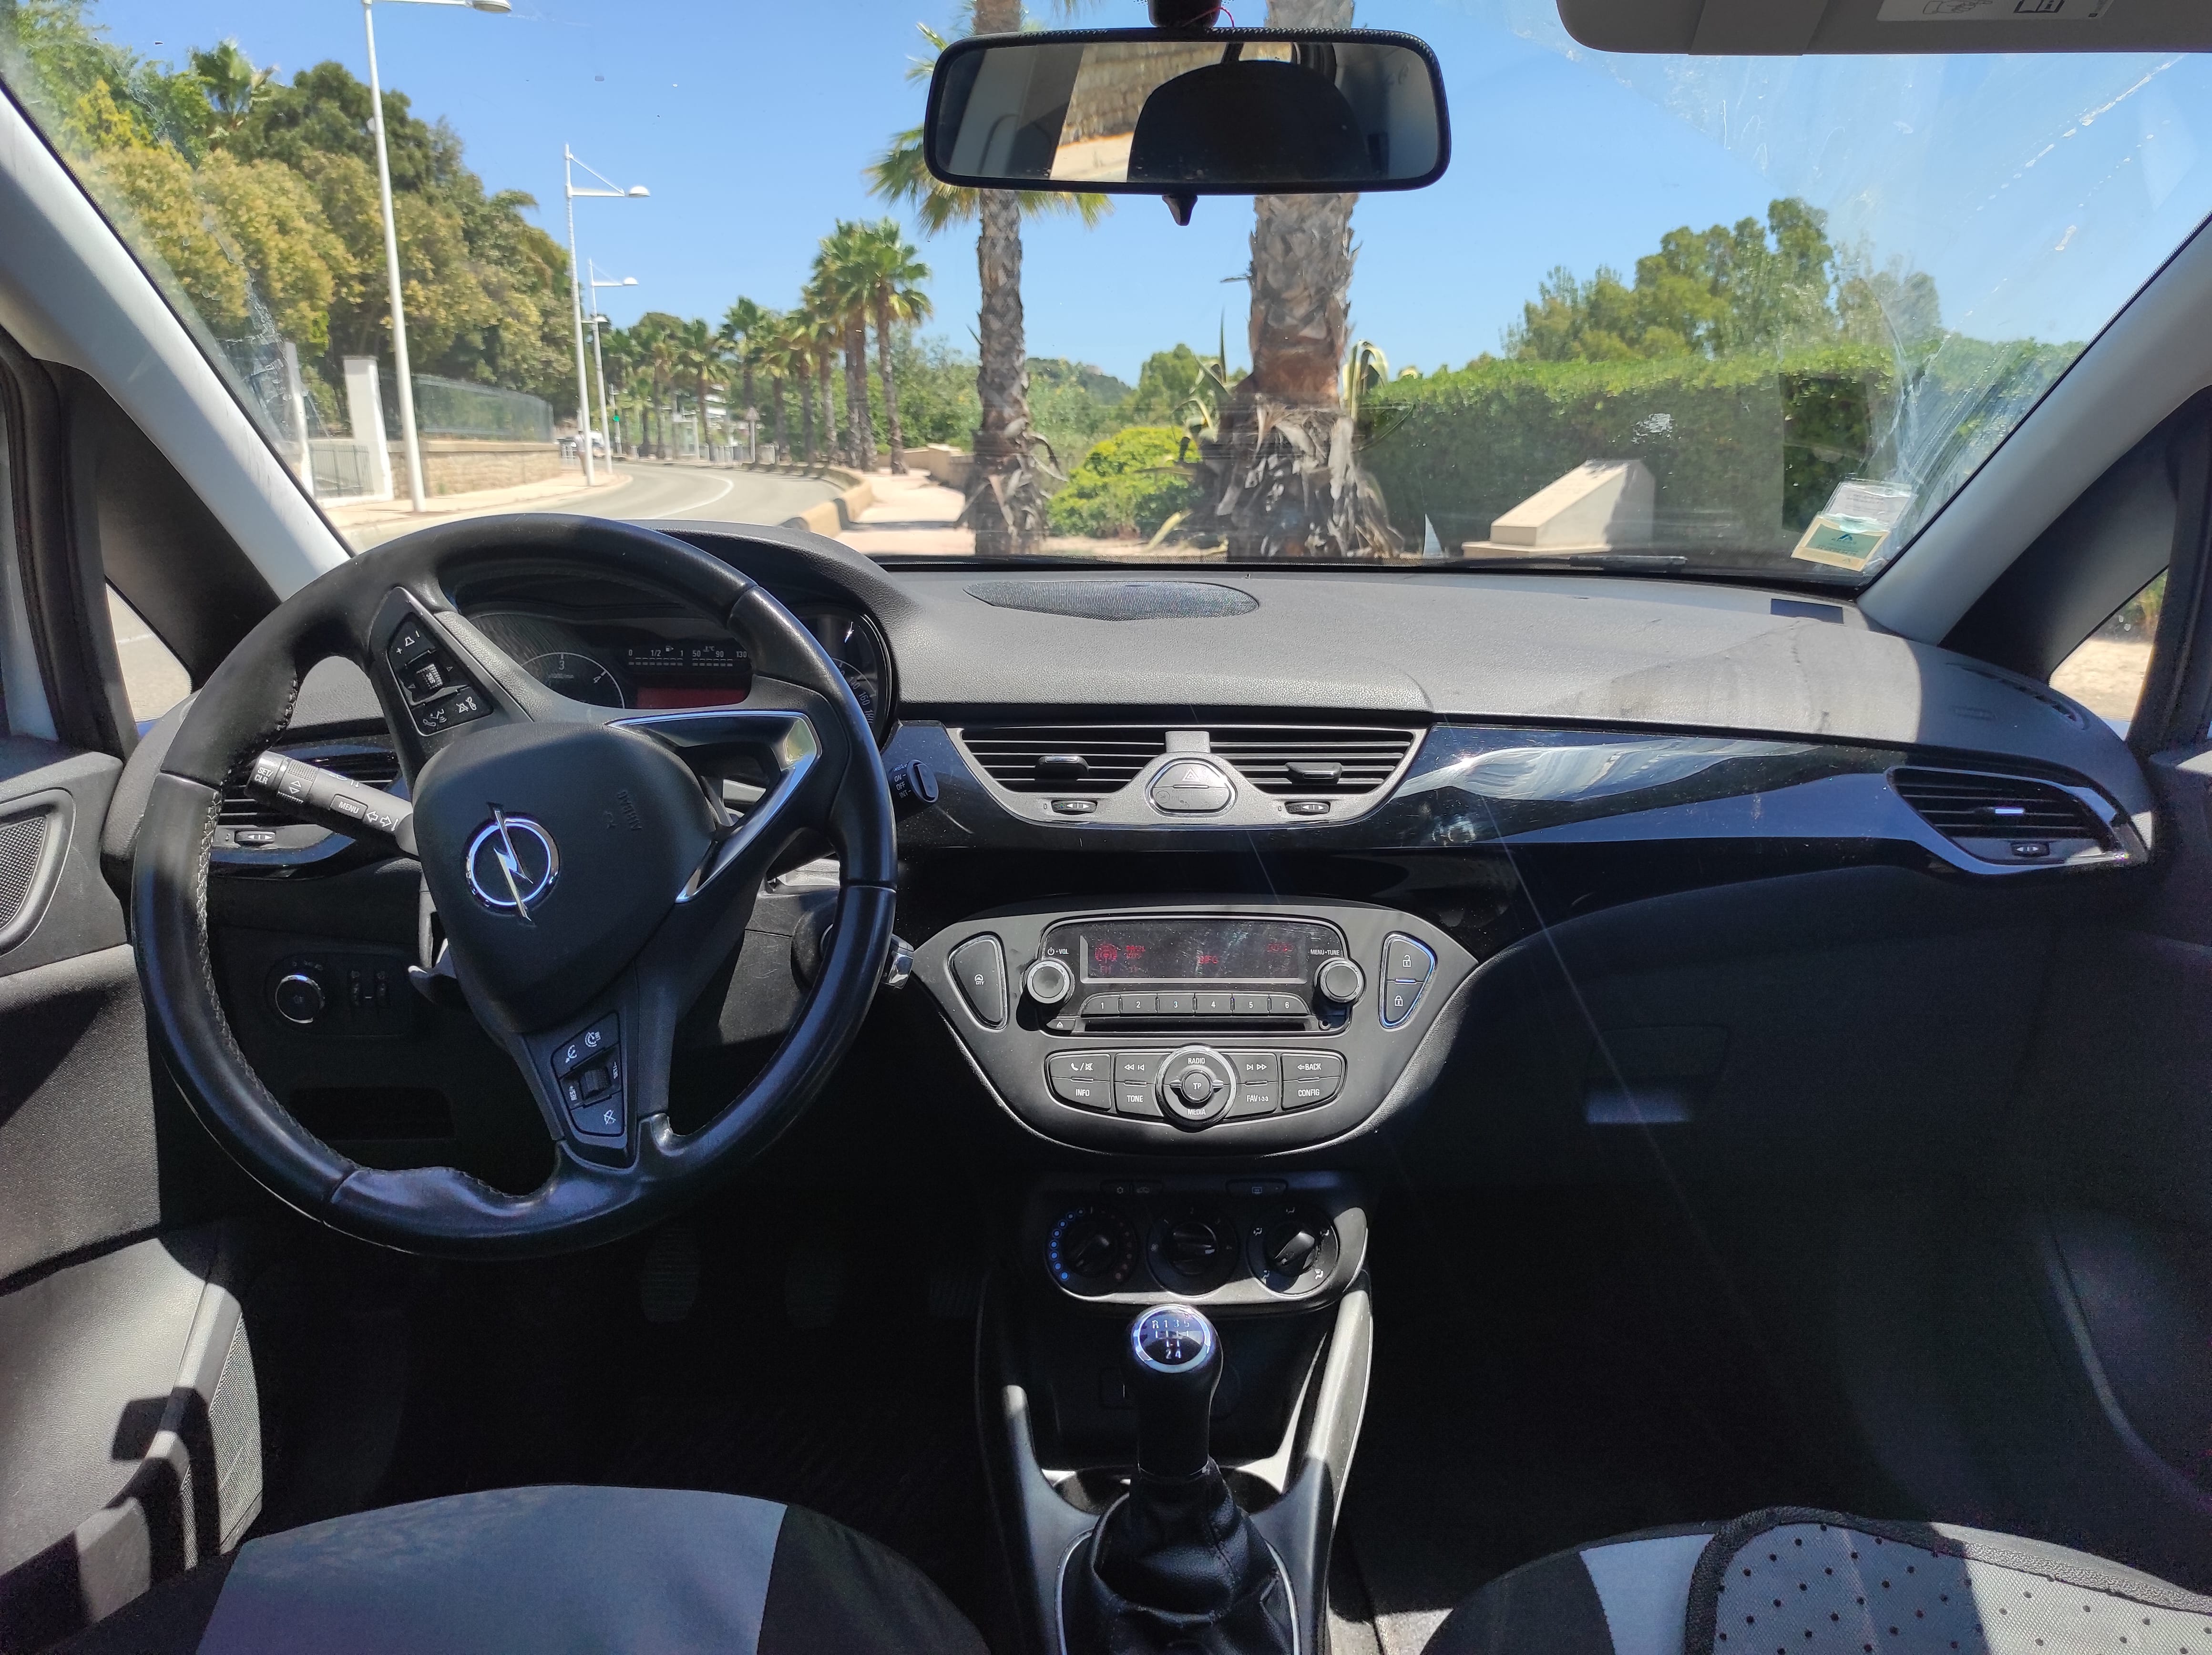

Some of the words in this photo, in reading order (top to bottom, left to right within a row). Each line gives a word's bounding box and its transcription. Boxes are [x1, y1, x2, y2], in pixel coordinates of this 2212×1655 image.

[559, 661, 565, 670] 3
[593, 675, 602, 684] 4
[859, 692, 870, 705] 160
[257, 767, 274, 777] SET/
[254, 775, 268, 785] CLR
[894, 774, 902, 782] ON
[896, 781, 906, 790] OFF
[899, 789, 908, 798] INT
[338, 800, 360, 814] MENU
[1075, 1088, 1090, 1097] INFO
[1298, 1088, 1320, 1097] CONFIG
[1188, 1108, 1206, 1116] MEDIA
[1151, 1319, 1159, 1329] R
[1163, 1319, 1168, 1328] 1
[1173, 1319, 1180, 1328] 3
[1183, 1319, 1190, 1328] 5
[1165, 1349, 1172, 1359] 2
[1175, 1349, 1182, 1359] 4
